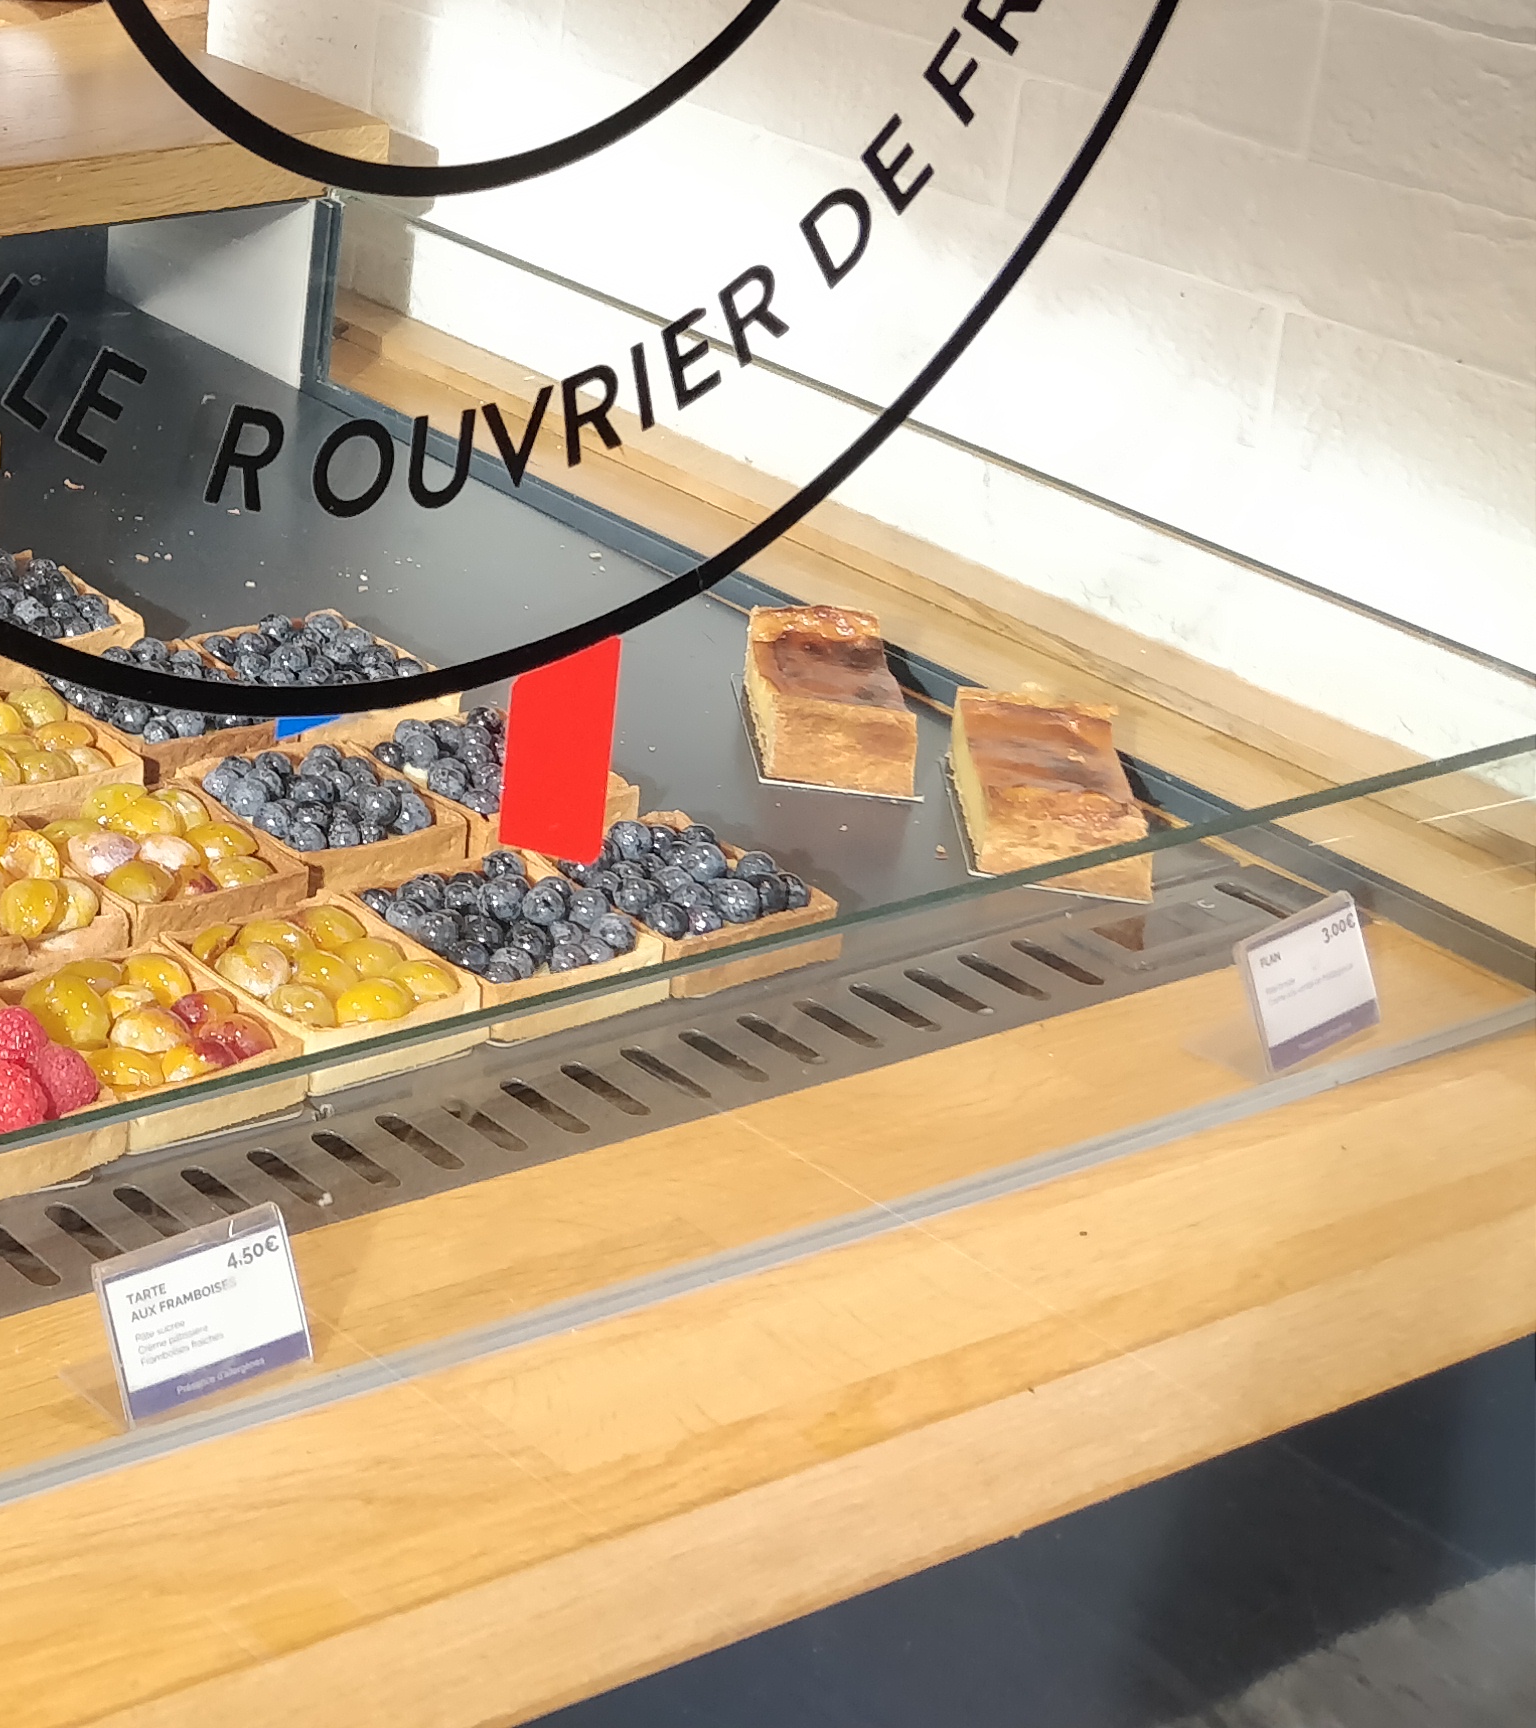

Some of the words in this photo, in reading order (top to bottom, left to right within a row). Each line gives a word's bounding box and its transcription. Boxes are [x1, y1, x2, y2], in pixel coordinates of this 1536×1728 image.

[799, 114, 933, 289] DE
[126, 1283, 167, 1305] TARTE
[131, 1305, 159, 1323] AUX
